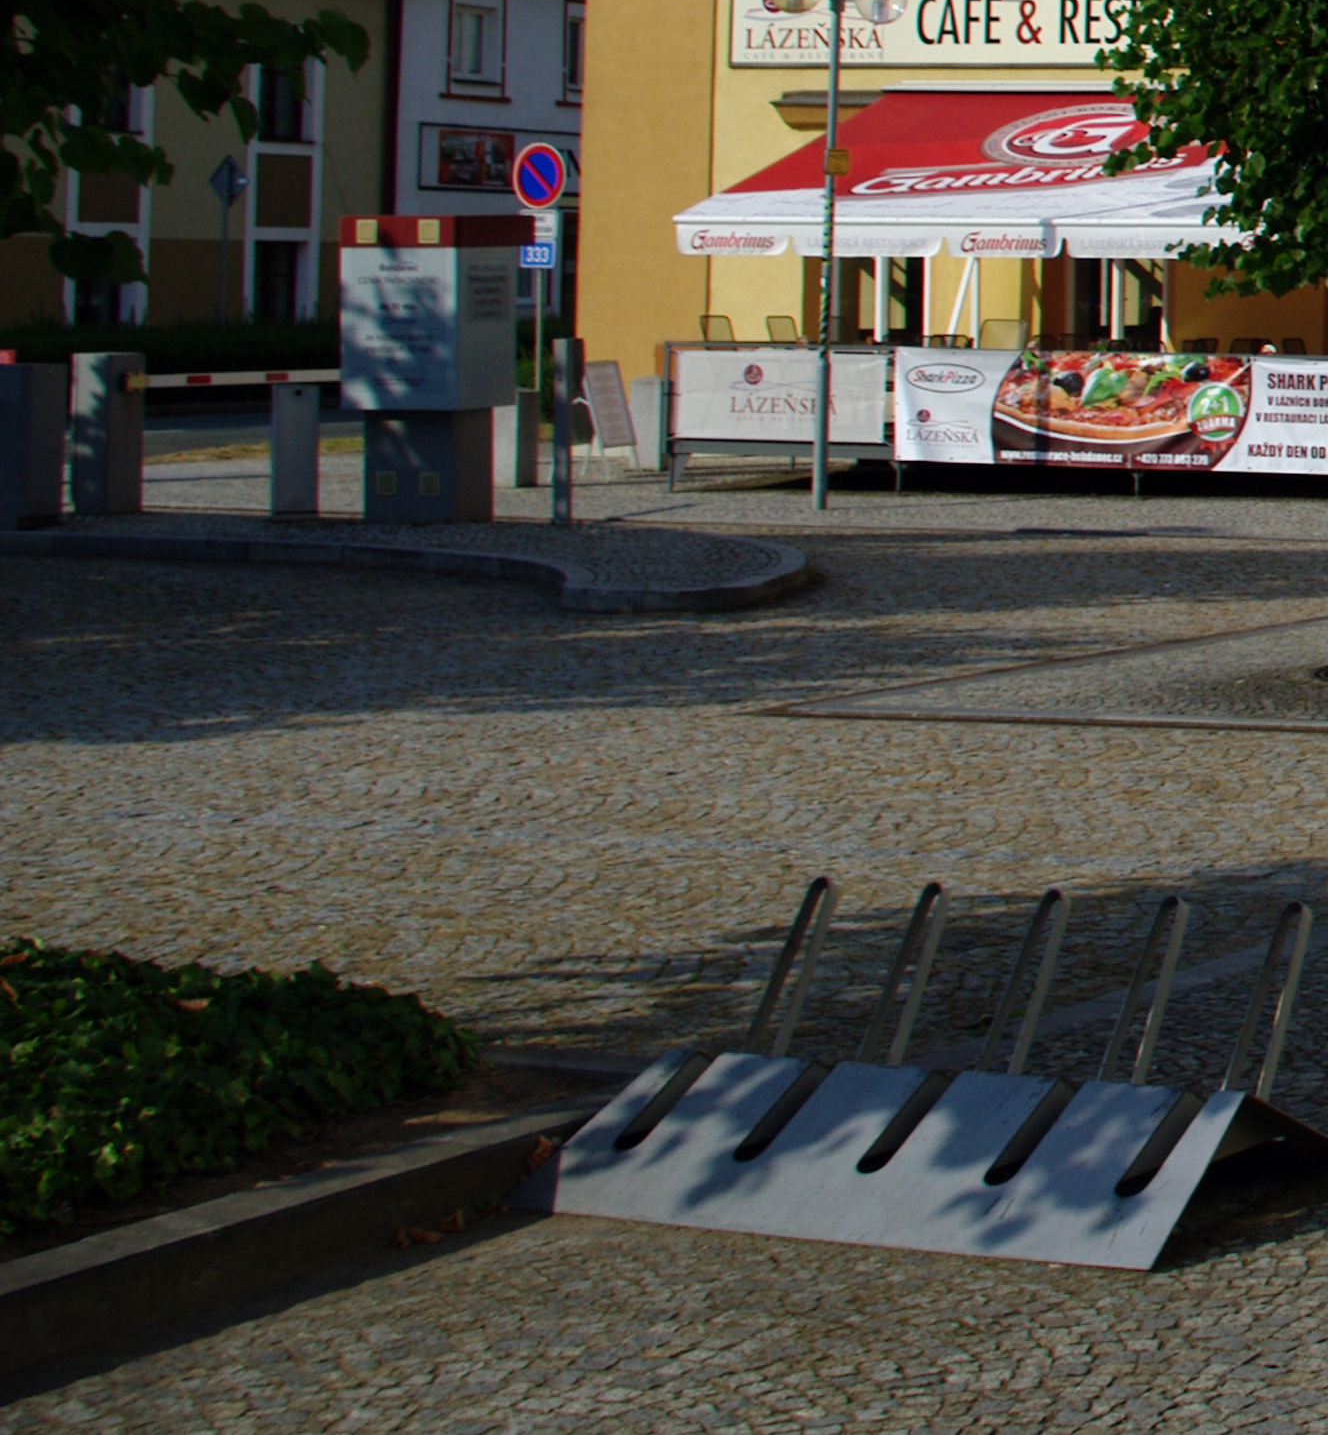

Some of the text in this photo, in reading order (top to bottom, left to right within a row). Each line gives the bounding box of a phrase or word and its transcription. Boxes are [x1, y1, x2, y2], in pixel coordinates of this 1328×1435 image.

[1016, 0, 1043, 45] &
[850, 153, 1188, 195] Gambris
[690, 229, 775, 251] Gambrinus
[960, 231, 1048, 253] Gambrinus
[525, 246, 550, 263] 333
[1267, 373, 1316, 391] SHARK
[1267, 396, 1274, 406] V
[1247, 442, 1284, 458] KAŽDÝ
[1286, 445, 1308, 459] DEN
[1310, 445, 1326, 460] OD
